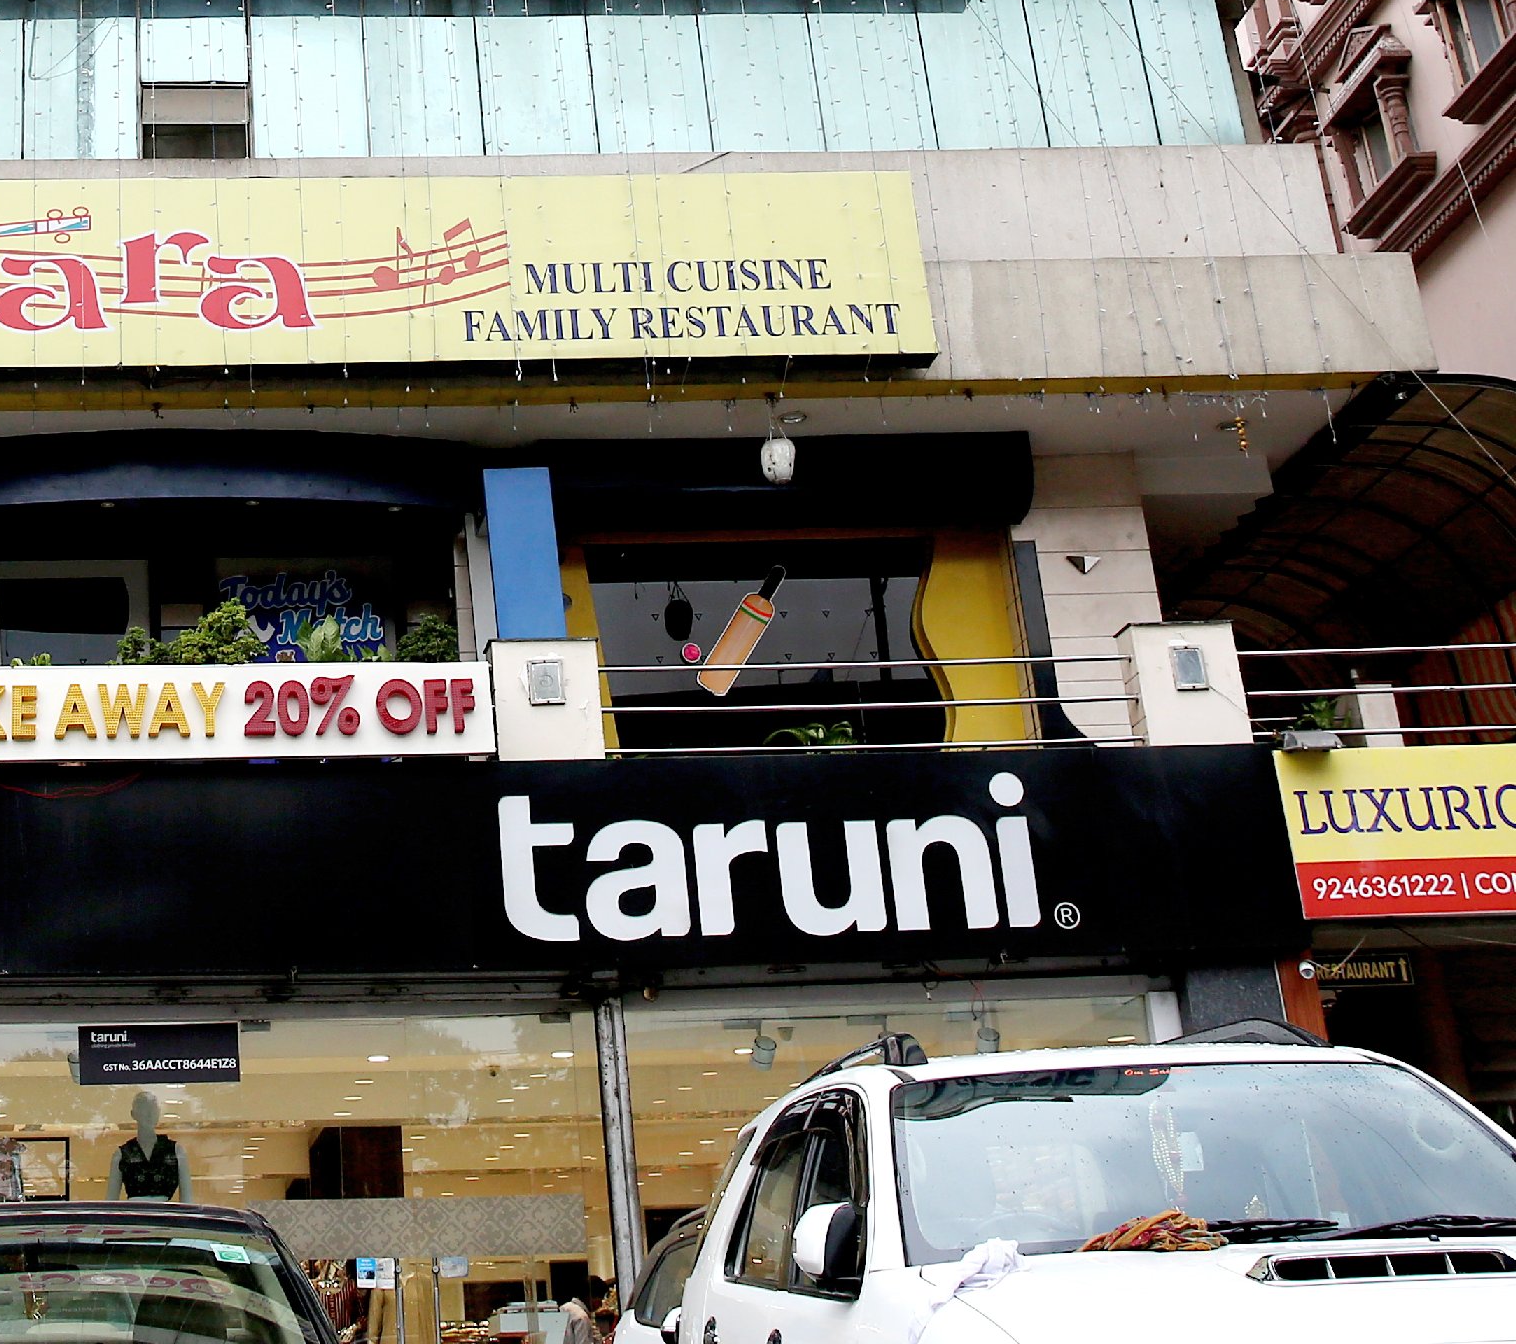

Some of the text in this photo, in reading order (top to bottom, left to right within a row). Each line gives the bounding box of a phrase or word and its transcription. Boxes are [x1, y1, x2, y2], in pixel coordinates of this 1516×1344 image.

[523, 258, 833, 297] MULTI CUISINE
[462, 303, 902, 343] FAMILY RESTAURANT
[218, 569, 353, 618] Today's
[55, 681, 226, 739] AWAY
[243, 674, 359, 737] 20%
[376, 678, 477, 735] OFF
[497, 771, 1042, 943] taruni
[1313, 874, 1456, 900] 9246361222
[90, 1030, 128, 1043] taruni
[102, 1062, 118, 1072] GST
[132, 1057, 237, 1071] 36AACCT8644E1Z8
